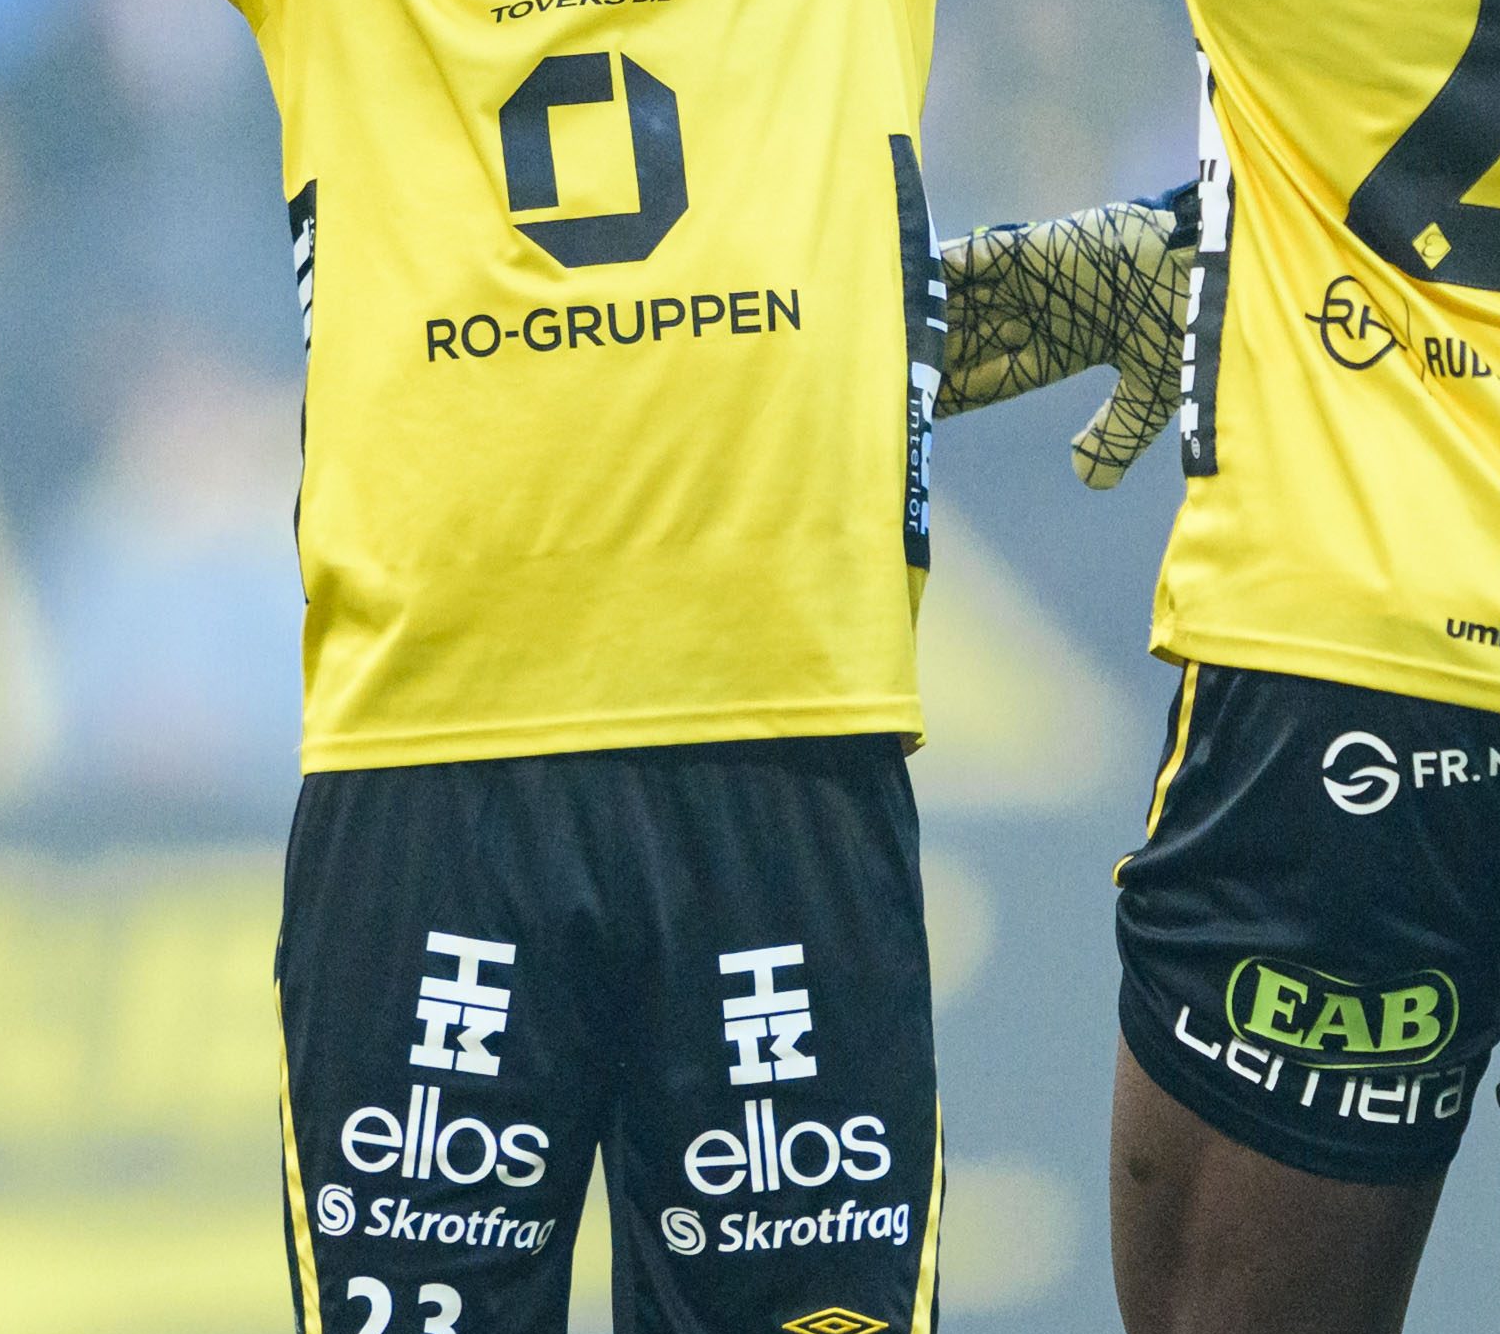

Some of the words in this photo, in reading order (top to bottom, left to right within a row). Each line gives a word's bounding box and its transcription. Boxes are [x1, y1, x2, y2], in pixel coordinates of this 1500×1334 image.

[426, 289, 802, 363] RO-GRUPPEN
[906, 397, 921, 535] interiör
[1411, 748, 1481, 787] FR.
[1244, 964, 1441, 1053] EAB
[340, 1084, 550, 1188] ellos
[684, 1098, 892, 1196] ellos
[364, 1196, 556, 1257] Skrotfrag
[718, 1198, 910, 1255] Skrotfrag
